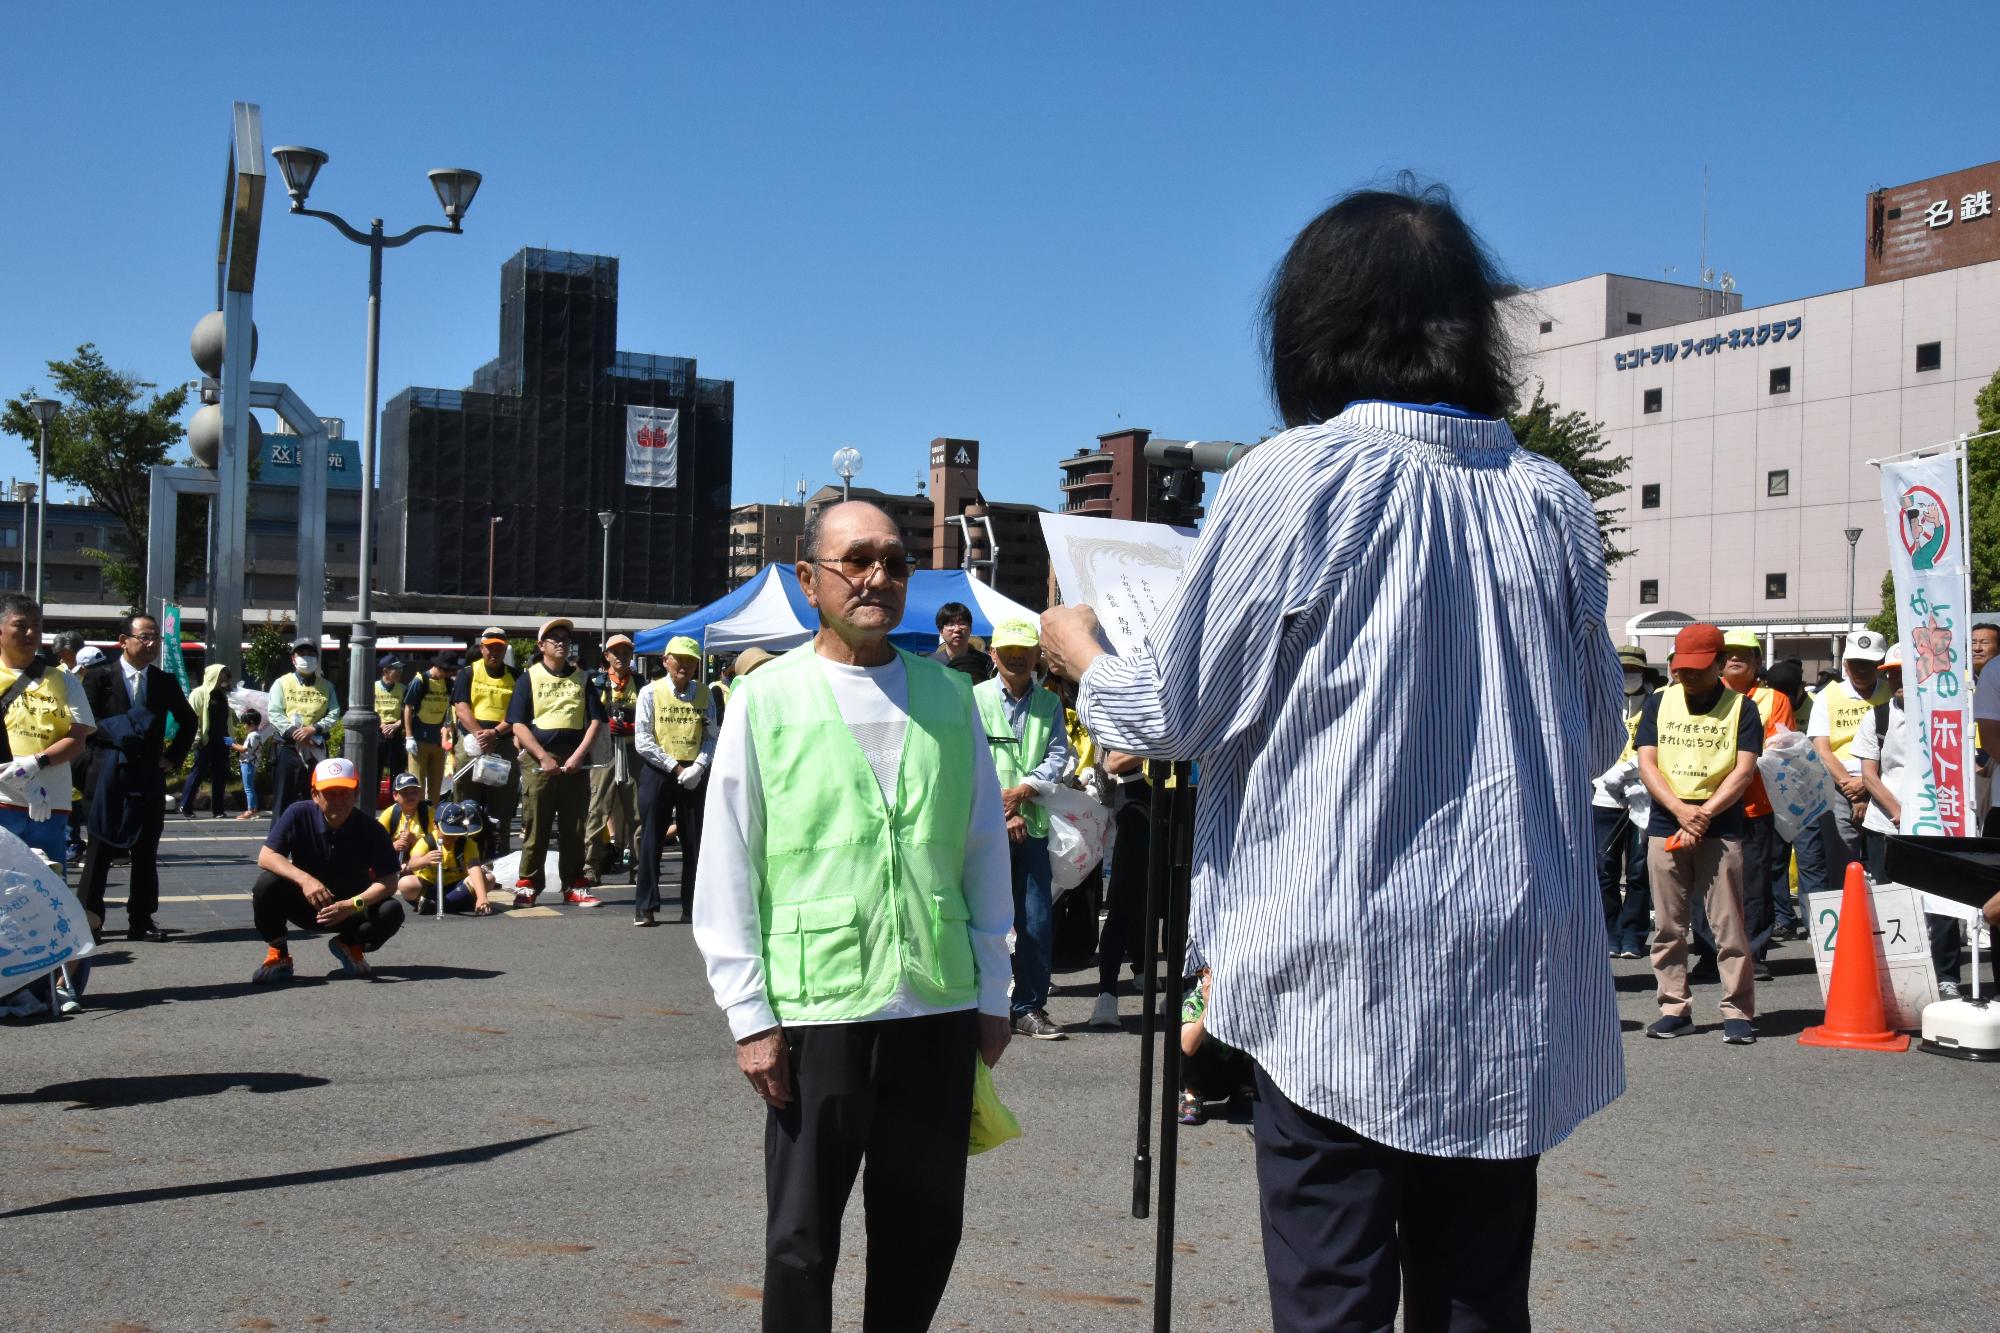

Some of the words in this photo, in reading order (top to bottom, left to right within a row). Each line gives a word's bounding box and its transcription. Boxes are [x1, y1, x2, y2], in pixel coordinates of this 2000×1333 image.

[1924, 190, 2000, 228] 名鉄
[1660, 734, 1729, 750] きれいなちづくり
